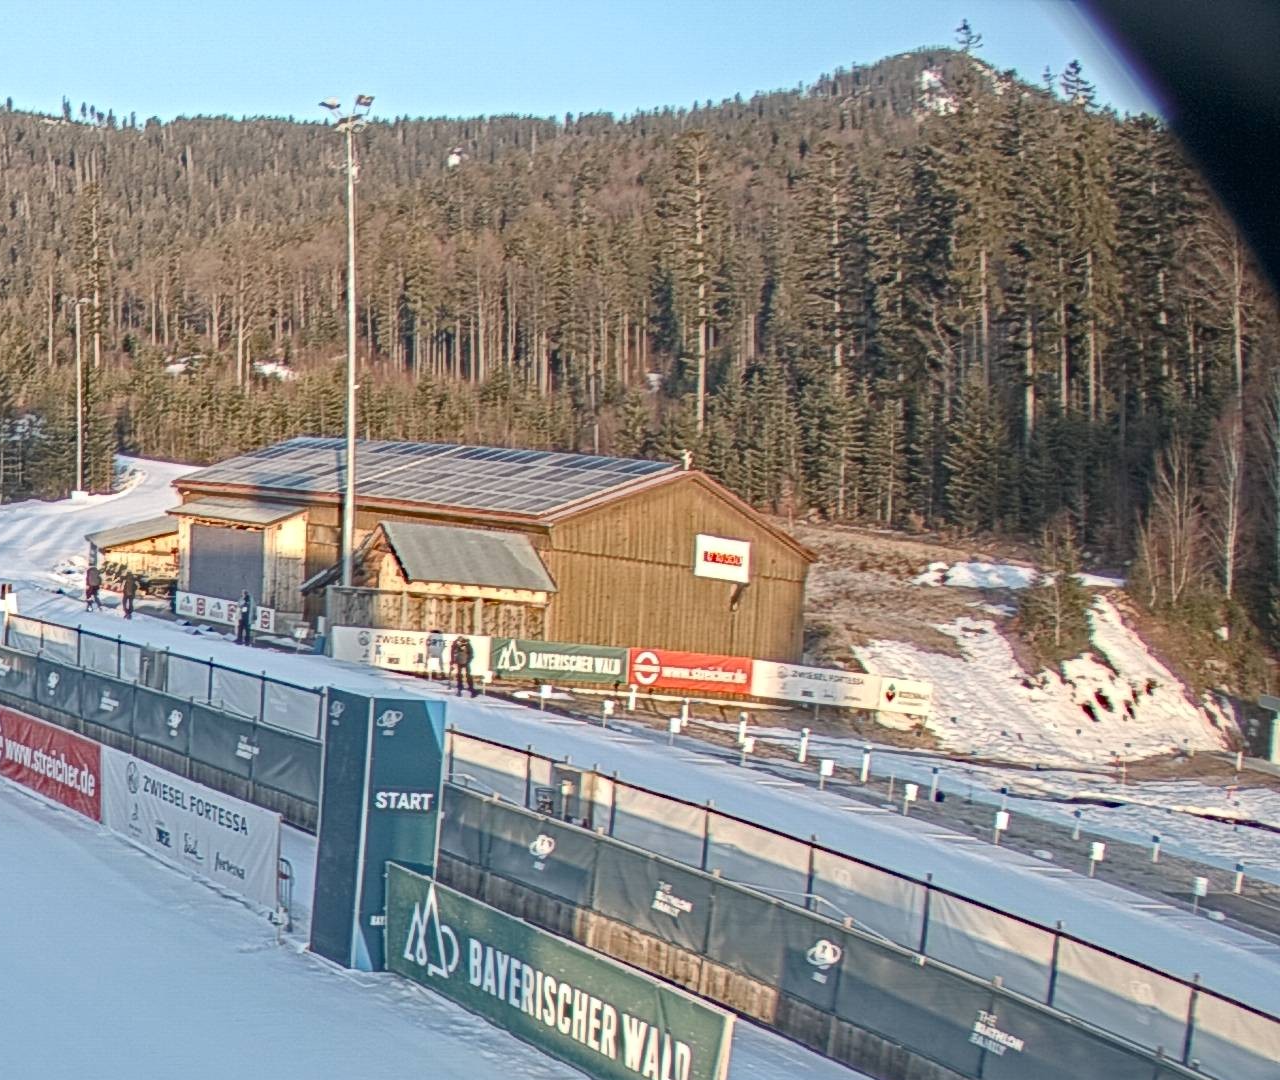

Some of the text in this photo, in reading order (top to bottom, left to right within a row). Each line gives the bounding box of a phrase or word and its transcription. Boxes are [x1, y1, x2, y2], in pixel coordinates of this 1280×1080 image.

[529, 651, 594, 674] BAYERISCHER
[5, 739, 96, 797] www.streicher.de
[143, 775, 249, 836] ZWIESEL FORTESSA
[375, 791, 434, 811] START
[469, 937, 619, 1061] BAYERISCHER
